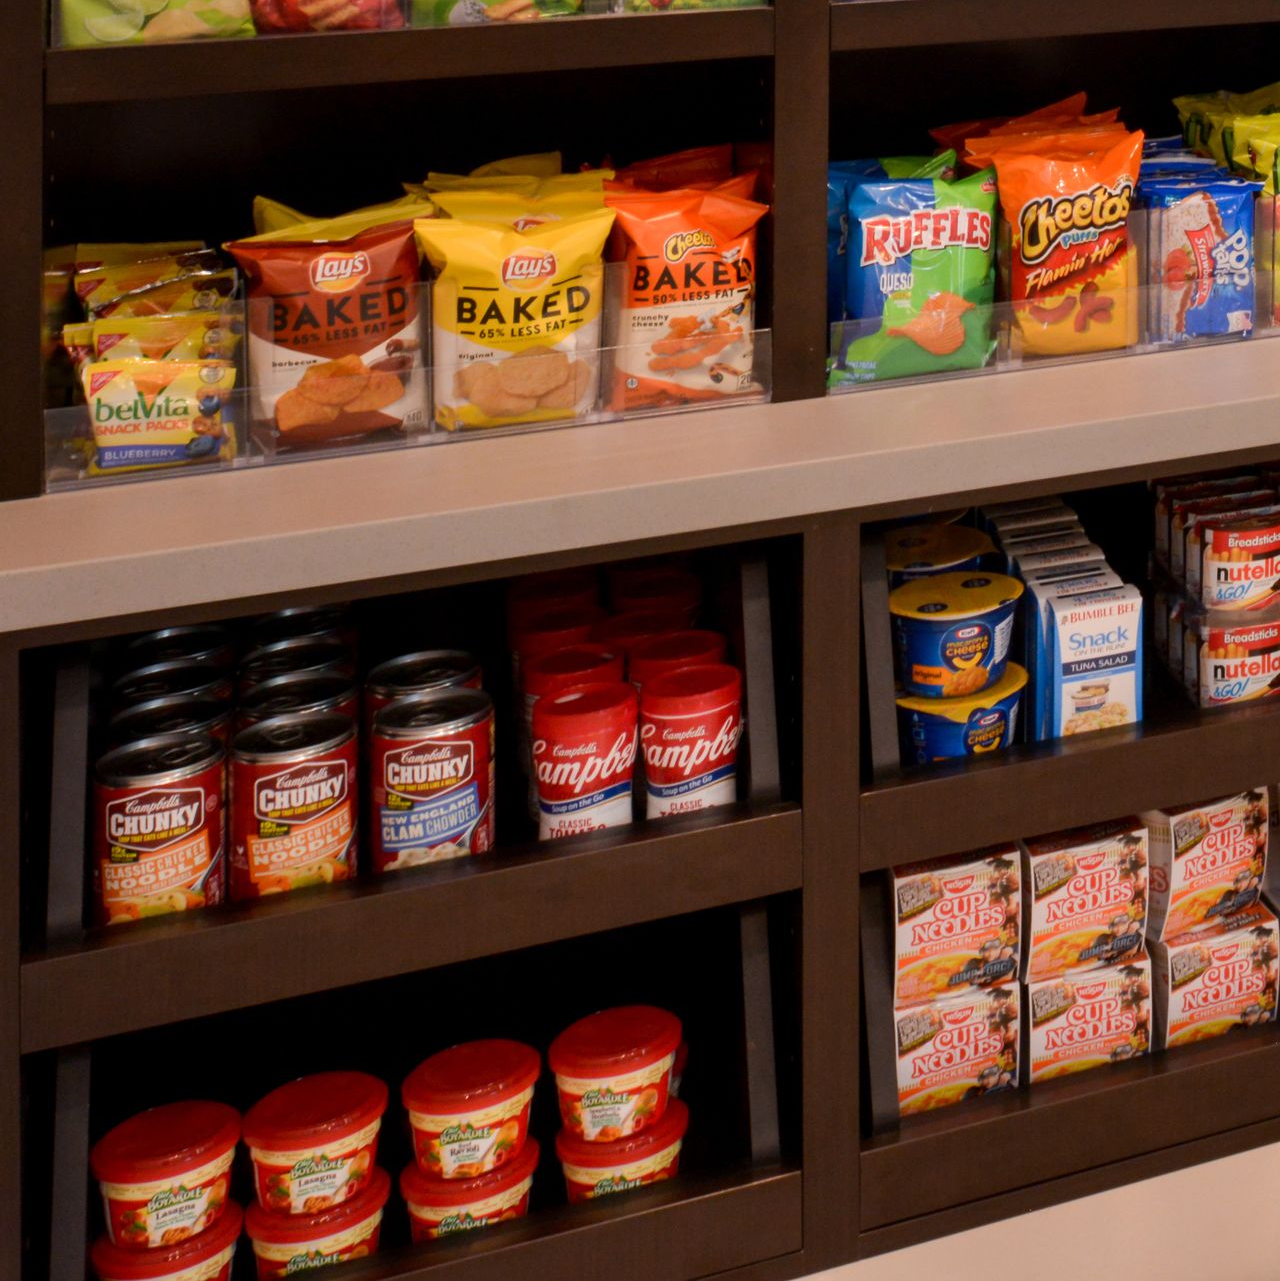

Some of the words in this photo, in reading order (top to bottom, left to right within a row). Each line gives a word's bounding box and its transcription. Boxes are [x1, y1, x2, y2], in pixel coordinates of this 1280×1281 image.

[1020, 183, 1132, 264] Cheetos
[860, 208, 992, 267] RUFFLES
[316, 255, 365, 283] Lay's
[505, 254, 554, 280] Lay's
[1025, 252, 1086, 296] Flamin'
[1090, 237, 1120, 265] Hot
[879, 272, 913, 294] QUESO
[457, 285, 591, 325] BAKED
[653, 293, 678, 305] 50%
[682, 290, 710, 302] LESS
[714, 288, 735, 300] FAT
[272, 290, 409, 332] BAKED
[632, 314, 669, 323] crunchy
[479, 328, 505, 339] 65%
[510, 325, 541, 338] LESS
[546, 319, 566, 333] FAT
[272, 359, 318, 368] barbecue
[459, 352, 494, 360] original
[95, 391, 190, 423] belVita
[96, 421, 141, 436] SNACK
[146, 419, 189, 431] PACKS
[104, 448, 176, 461] BLUEBERRY
[1070, 607, 1113, 624] BUMBLE
[1117, 603, 1138, 616] BEE
[1069, 627, 1128, 651] Snack
[1224, 628, 1278, 644] Breadsticks
[1074, 647, 1088, 656] ON
[1089, 645, 1105, 655] THE
[1071, 662, 1097, 672] TUNA
[1098, 655, 1128, 669] SALAD
[387, 754, 468, 787] CHUNKY
[259, 778, 344, 814] CHUNKY
[662, 787, 678, 797] Soup
[690, 779, 701, 789] the
[702, 773, 713, 784] Go
[382, 813, 407, 827] NEW
[410, 794, 475, 822] ENGLAND
[670, 799, 702, 811] CLASSIC
[110, 804, 198, 836] CHUNKY
[383, 822, 424, 841] CLAM
[425, 803, 478, 832] CHOWDER
[559, 817, 592, 828] CLASSIC
[253, 826, 350, 866] NOODLE
[106, 852, 207, 891] NOODLE
[925, 936, 973, 953] CHICKEN
[1201, 959, 1249, 988] CUP
[1182, 969, 1265, 1013] NOODLES
[1058, 1041, 1104, 1057] CHICKEN
[298, 1172, 338, 1187] Lasagna
[156, 1202, 196, 1220] Lasagna
